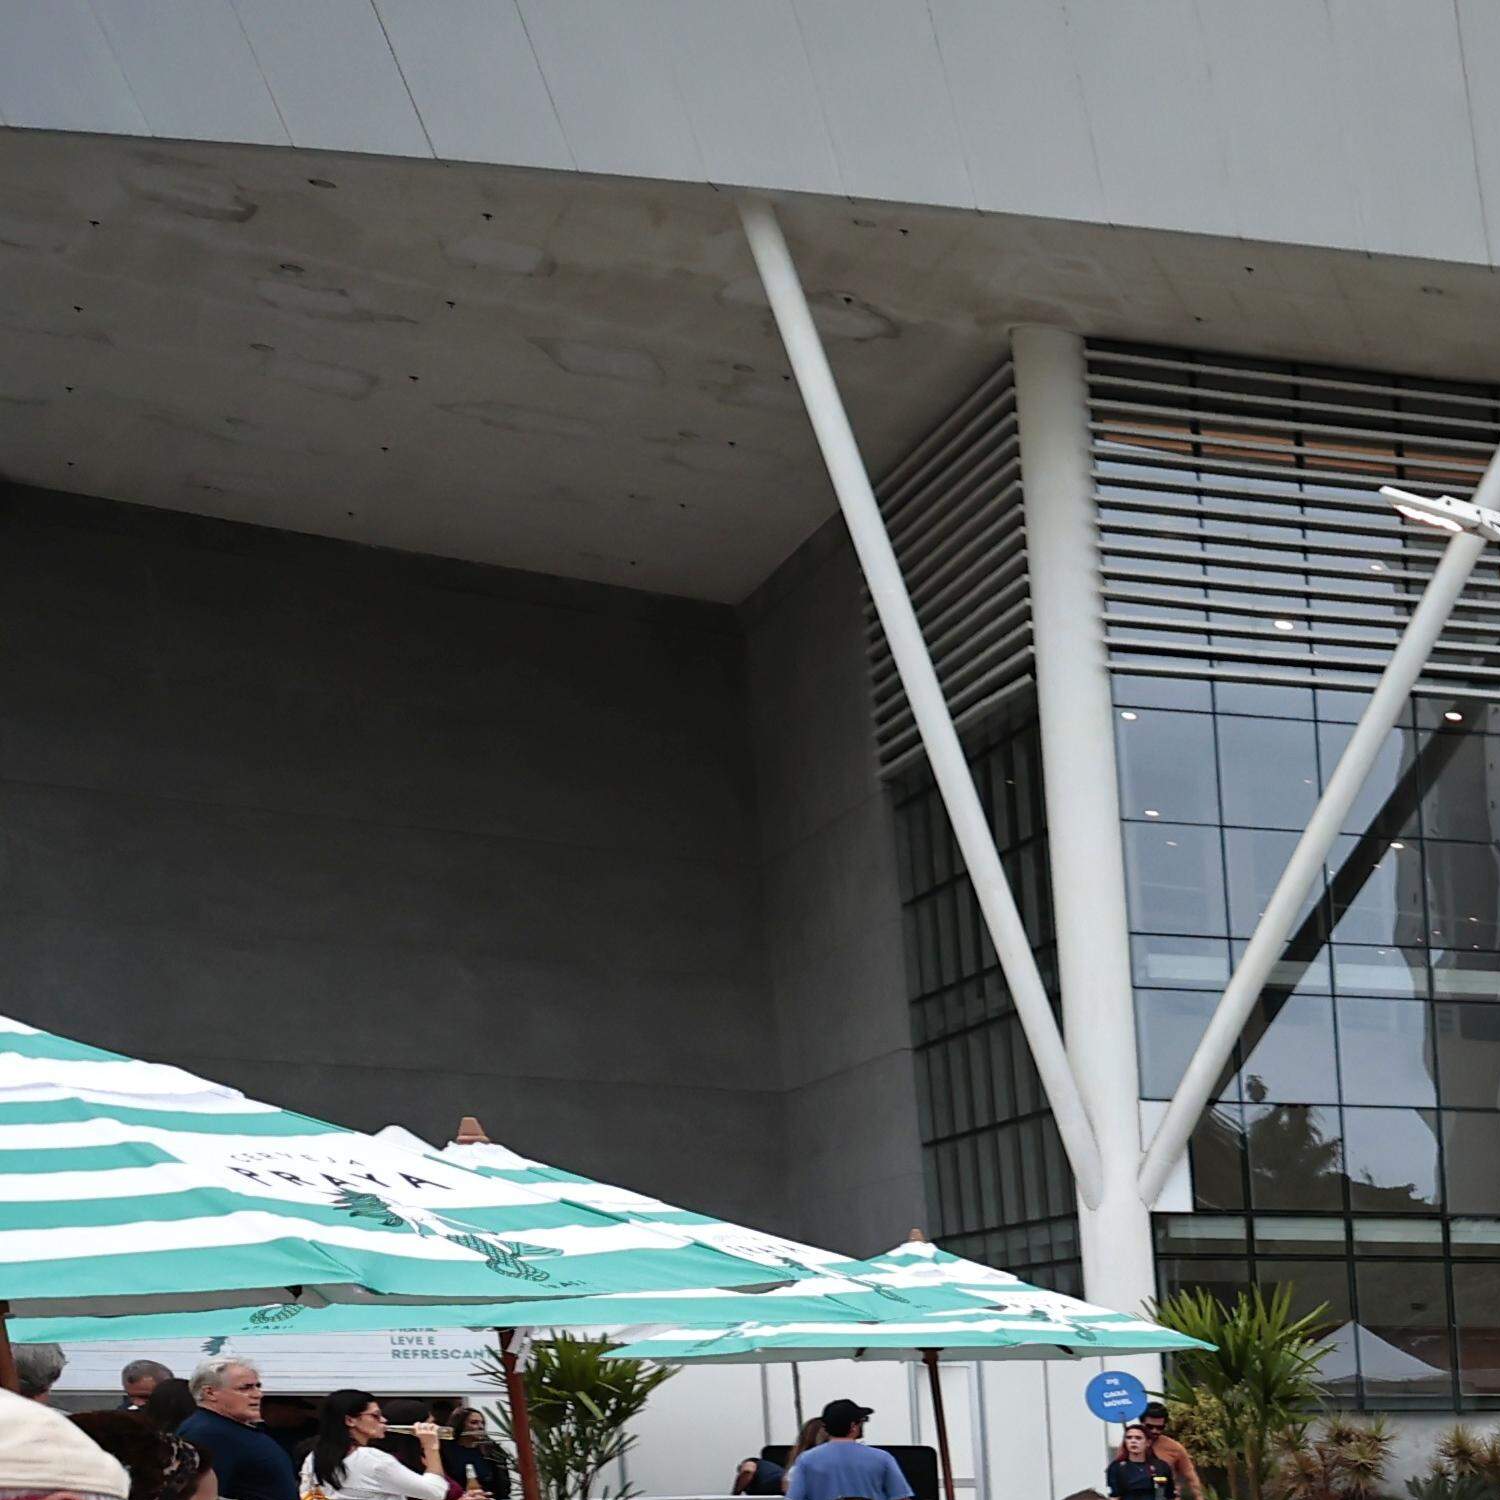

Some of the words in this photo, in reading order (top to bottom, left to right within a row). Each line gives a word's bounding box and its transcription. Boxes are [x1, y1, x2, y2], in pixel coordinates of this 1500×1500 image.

[227, 1166, 456, 1191] PRAYA
[390, 1336, 423, 1346] LEVE
[428, 1336, 436, 1346] E
